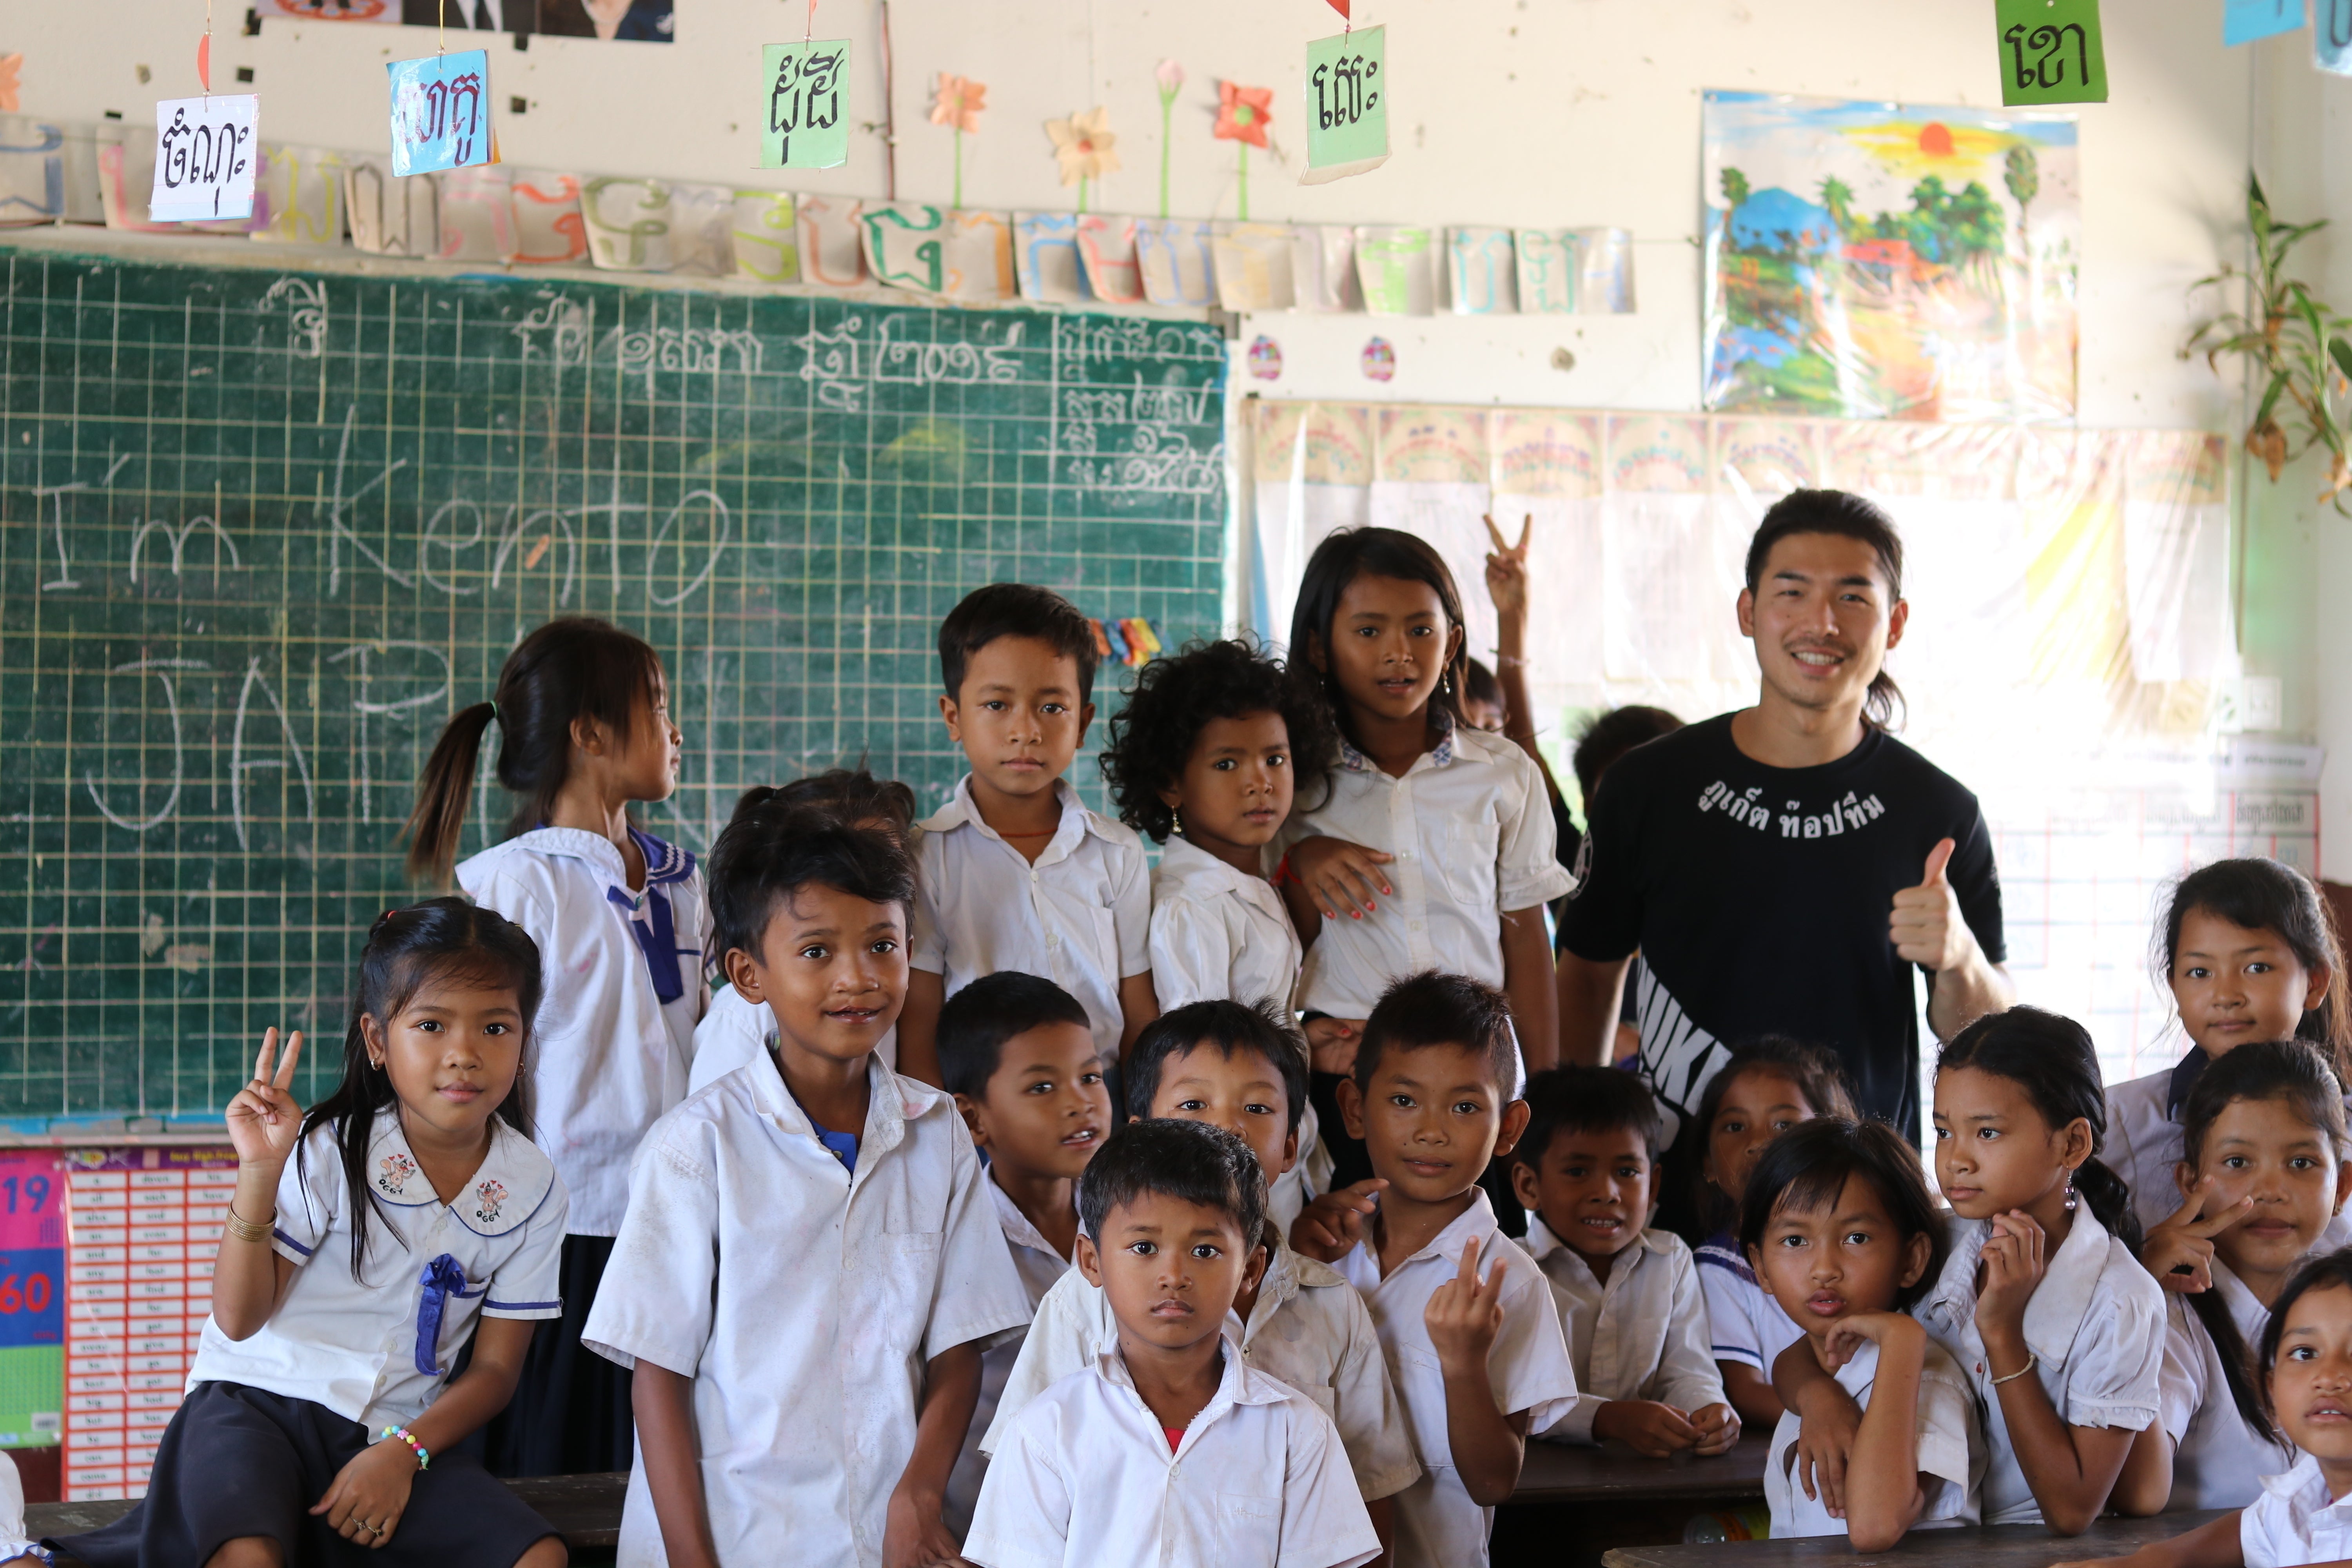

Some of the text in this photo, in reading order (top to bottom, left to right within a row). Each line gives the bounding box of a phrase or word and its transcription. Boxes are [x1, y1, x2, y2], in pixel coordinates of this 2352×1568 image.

[2004, 23, 2089, 89] ខោ
[770, 48, 845, 166] ដុំដី
[1312, 54, 1378, 130] សេះ
[162, 107, 249, 217] ចំណុះ
[1697, 780, 1770, 831] ภูเก็ต
[2, 1174, 50, 1214] 19
[378, 1179, 403, 1195] OGGY
[476, 1209, 501, 1222] OGGY
[0, 1272, 51, 1314] 60
